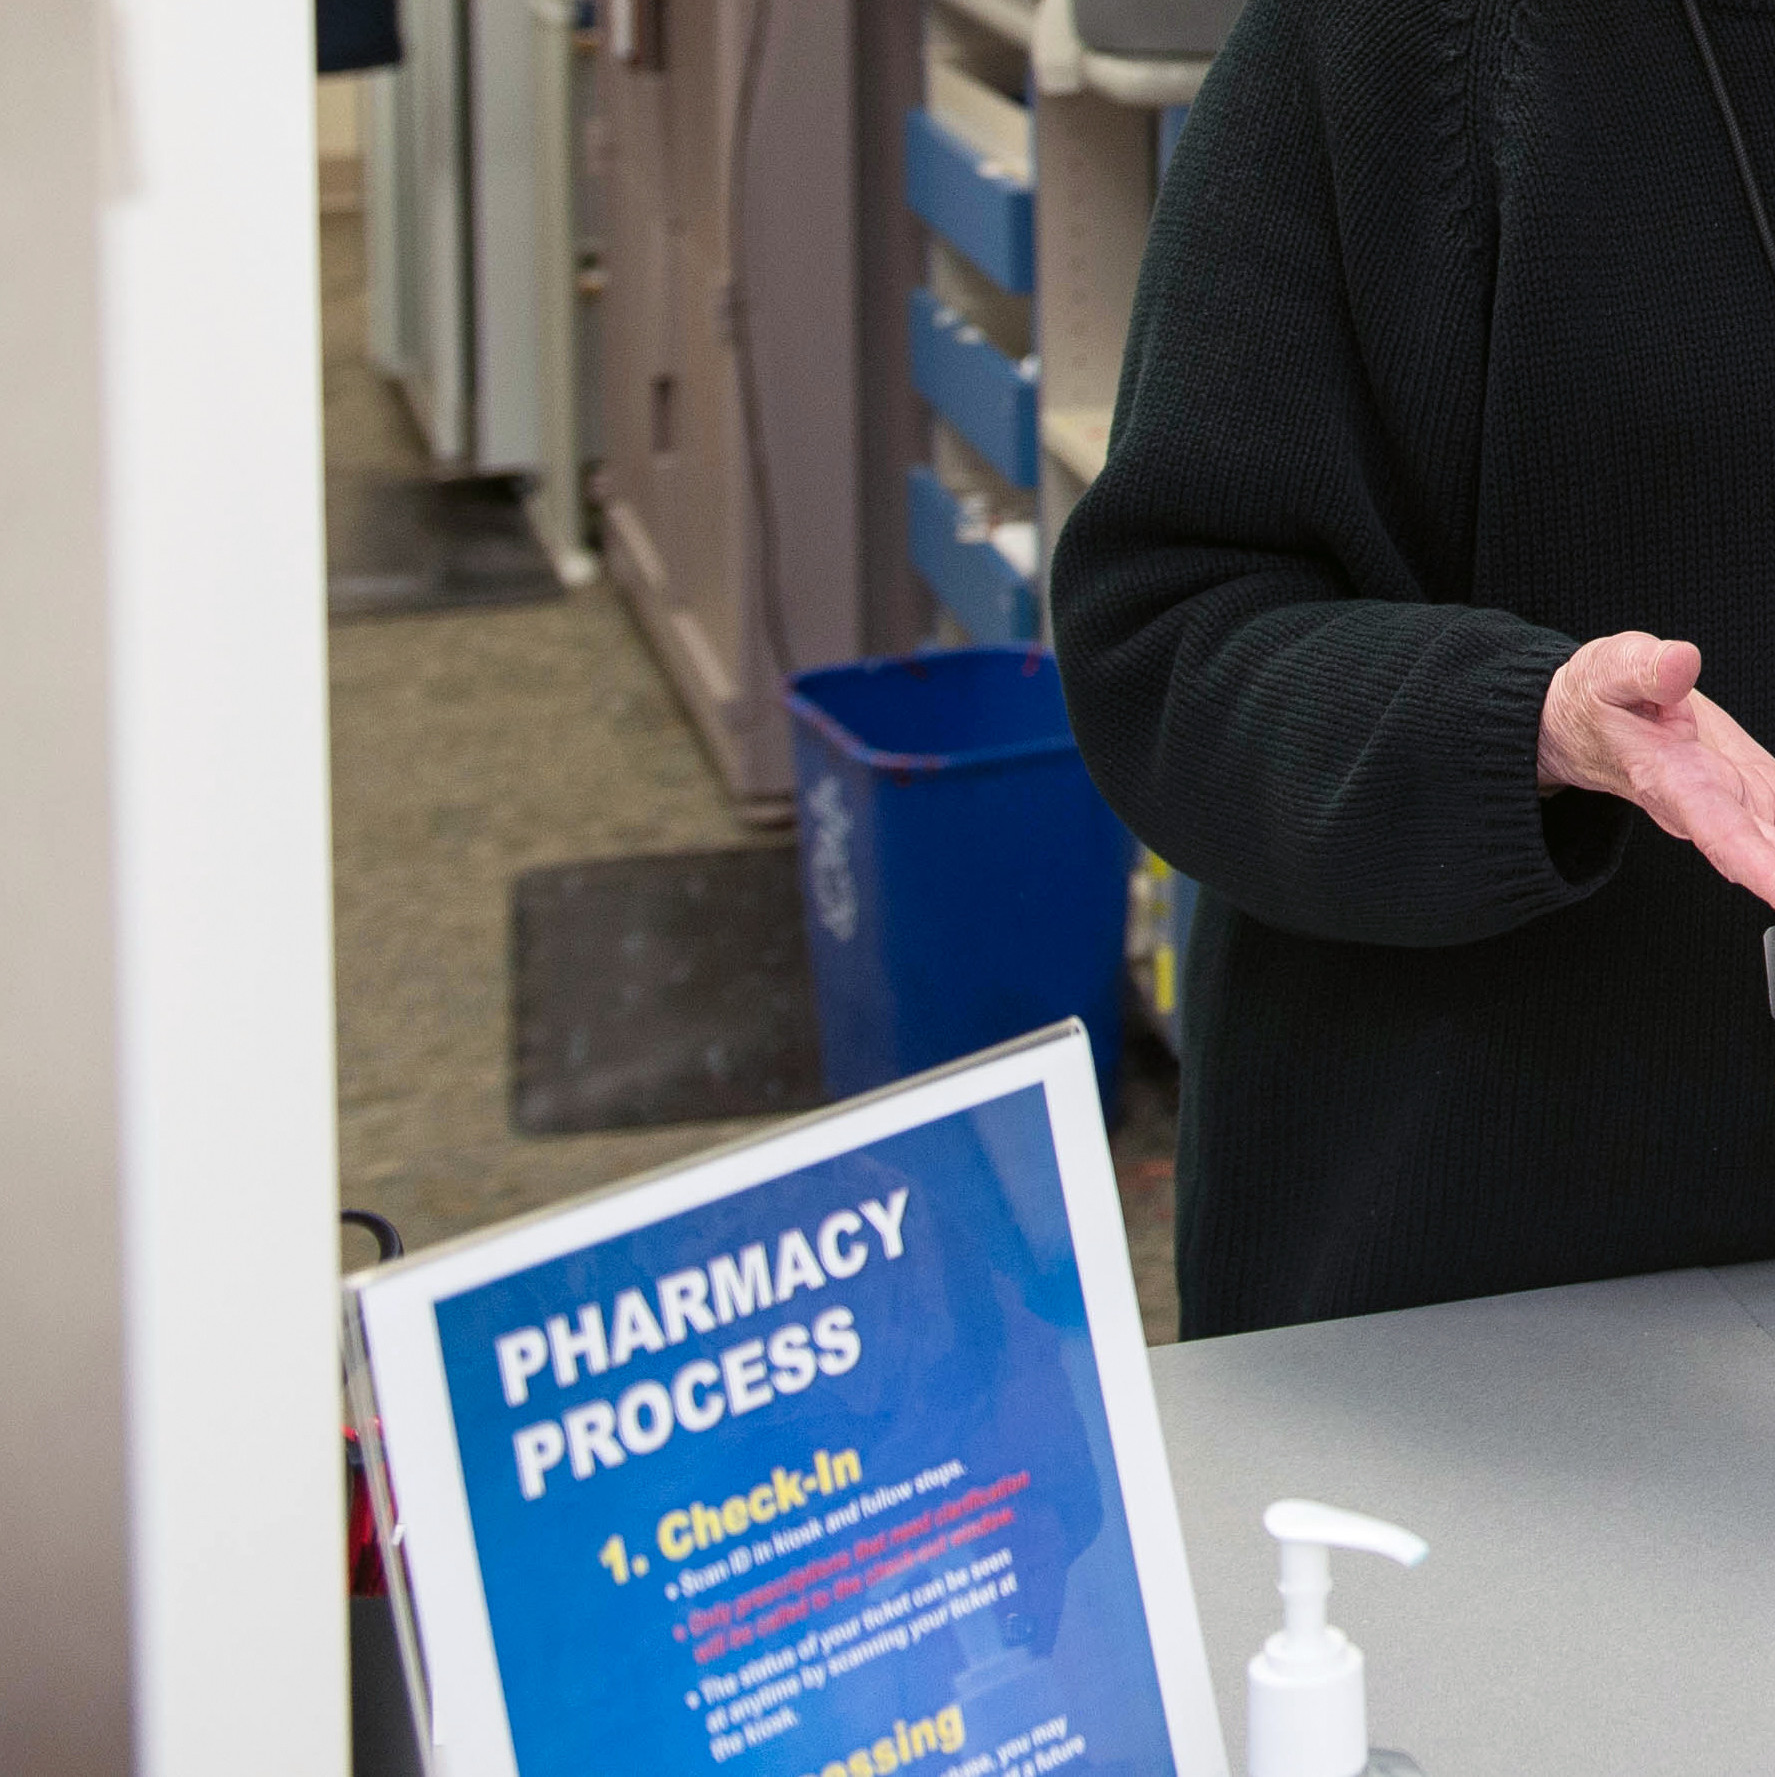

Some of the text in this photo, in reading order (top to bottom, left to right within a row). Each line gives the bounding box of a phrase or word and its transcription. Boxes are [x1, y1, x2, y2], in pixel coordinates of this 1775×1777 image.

[495, 1187, 912, 1408] PHARMACY
[511, 1305, 863, 1502] PROCESS
[600, 1448, 863, 1586] 1. Check-In
[679, 1559, 730, 1598] Scan
[728, 1545, 753, 1576] ID
[751, 1539, 774, 1566] in
[772, 1517, 824, 1558] kiosk
[824, 1500, 861, 1535] and
[859, 1480, 914, 1518] follow
[702, 1547, 1013, 1704] The status of your ticket can be seen
[705, 1571, 1018, 1734] at anytime by scanning your ticket at
[710, 1731, 744, 1763] the
